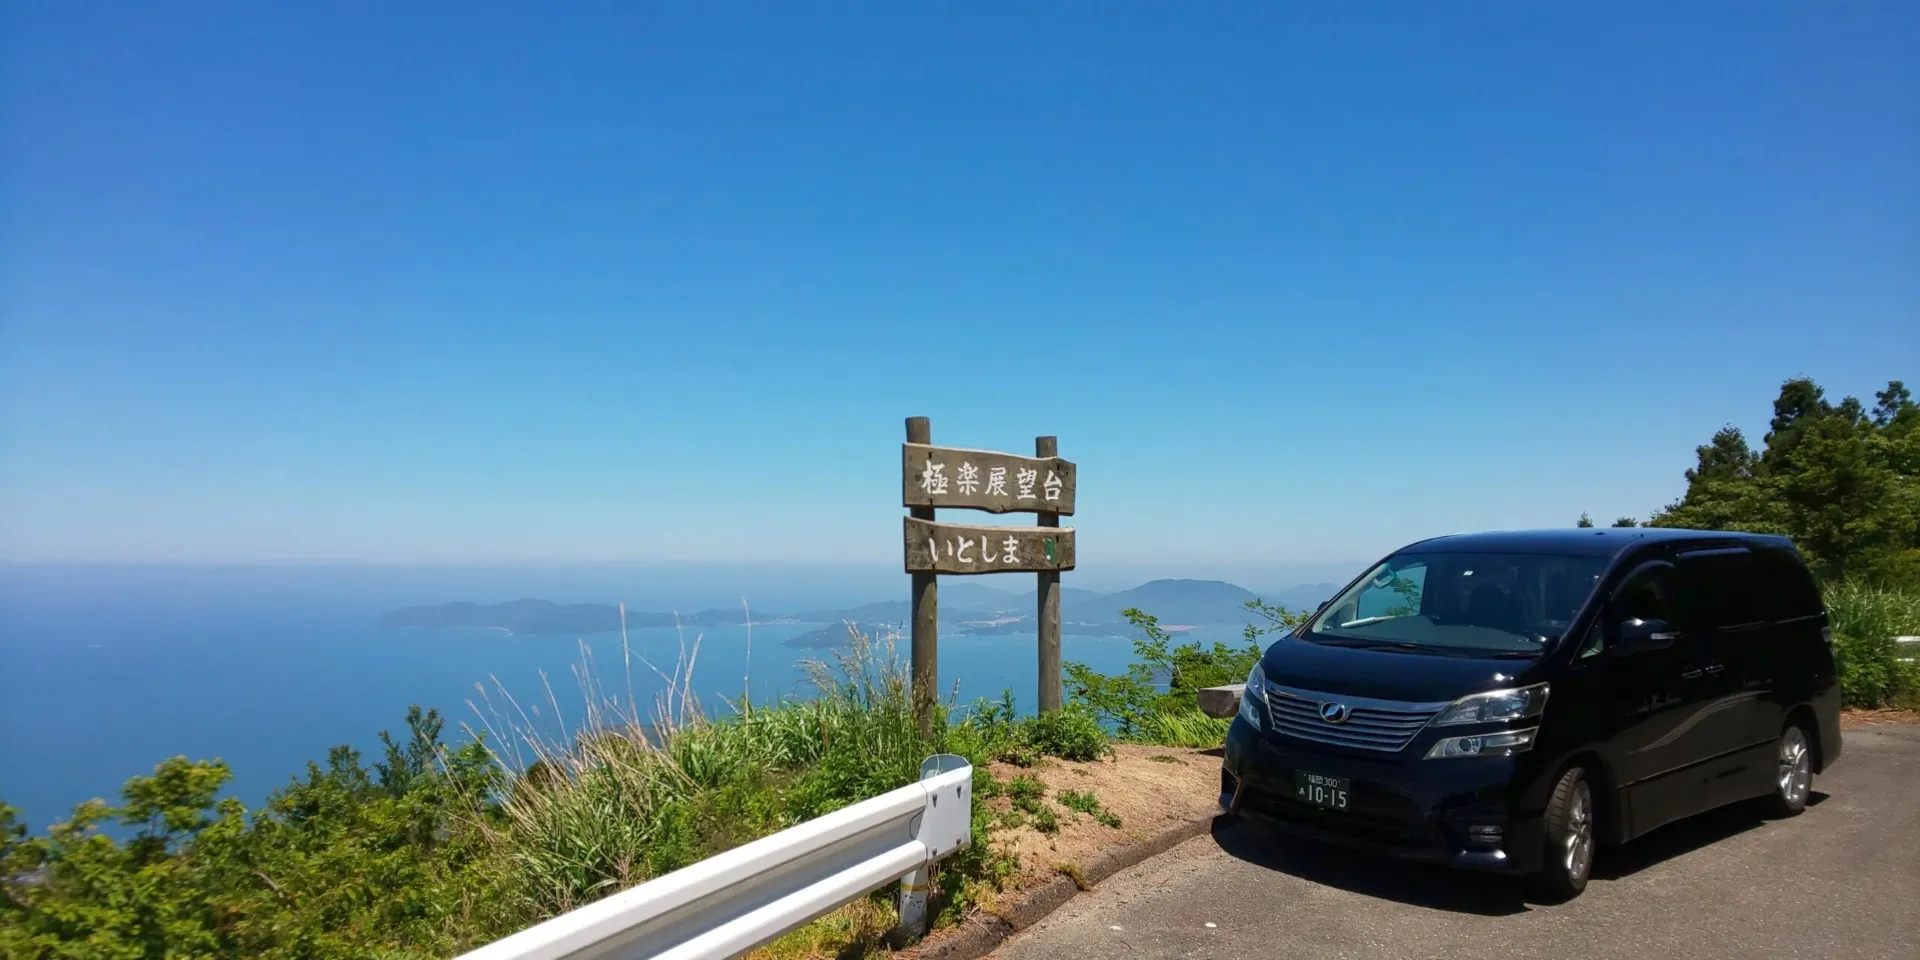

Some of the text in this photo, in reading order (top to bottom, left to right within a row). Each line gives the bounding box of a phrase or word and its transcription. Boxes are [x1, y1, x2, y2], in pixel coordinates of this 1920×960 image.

[921, 460, 1063, 500] 極楽展望台
[929, 535, 1020, 563] いとしま
[1309, 784, 1347, 808] 10-15
